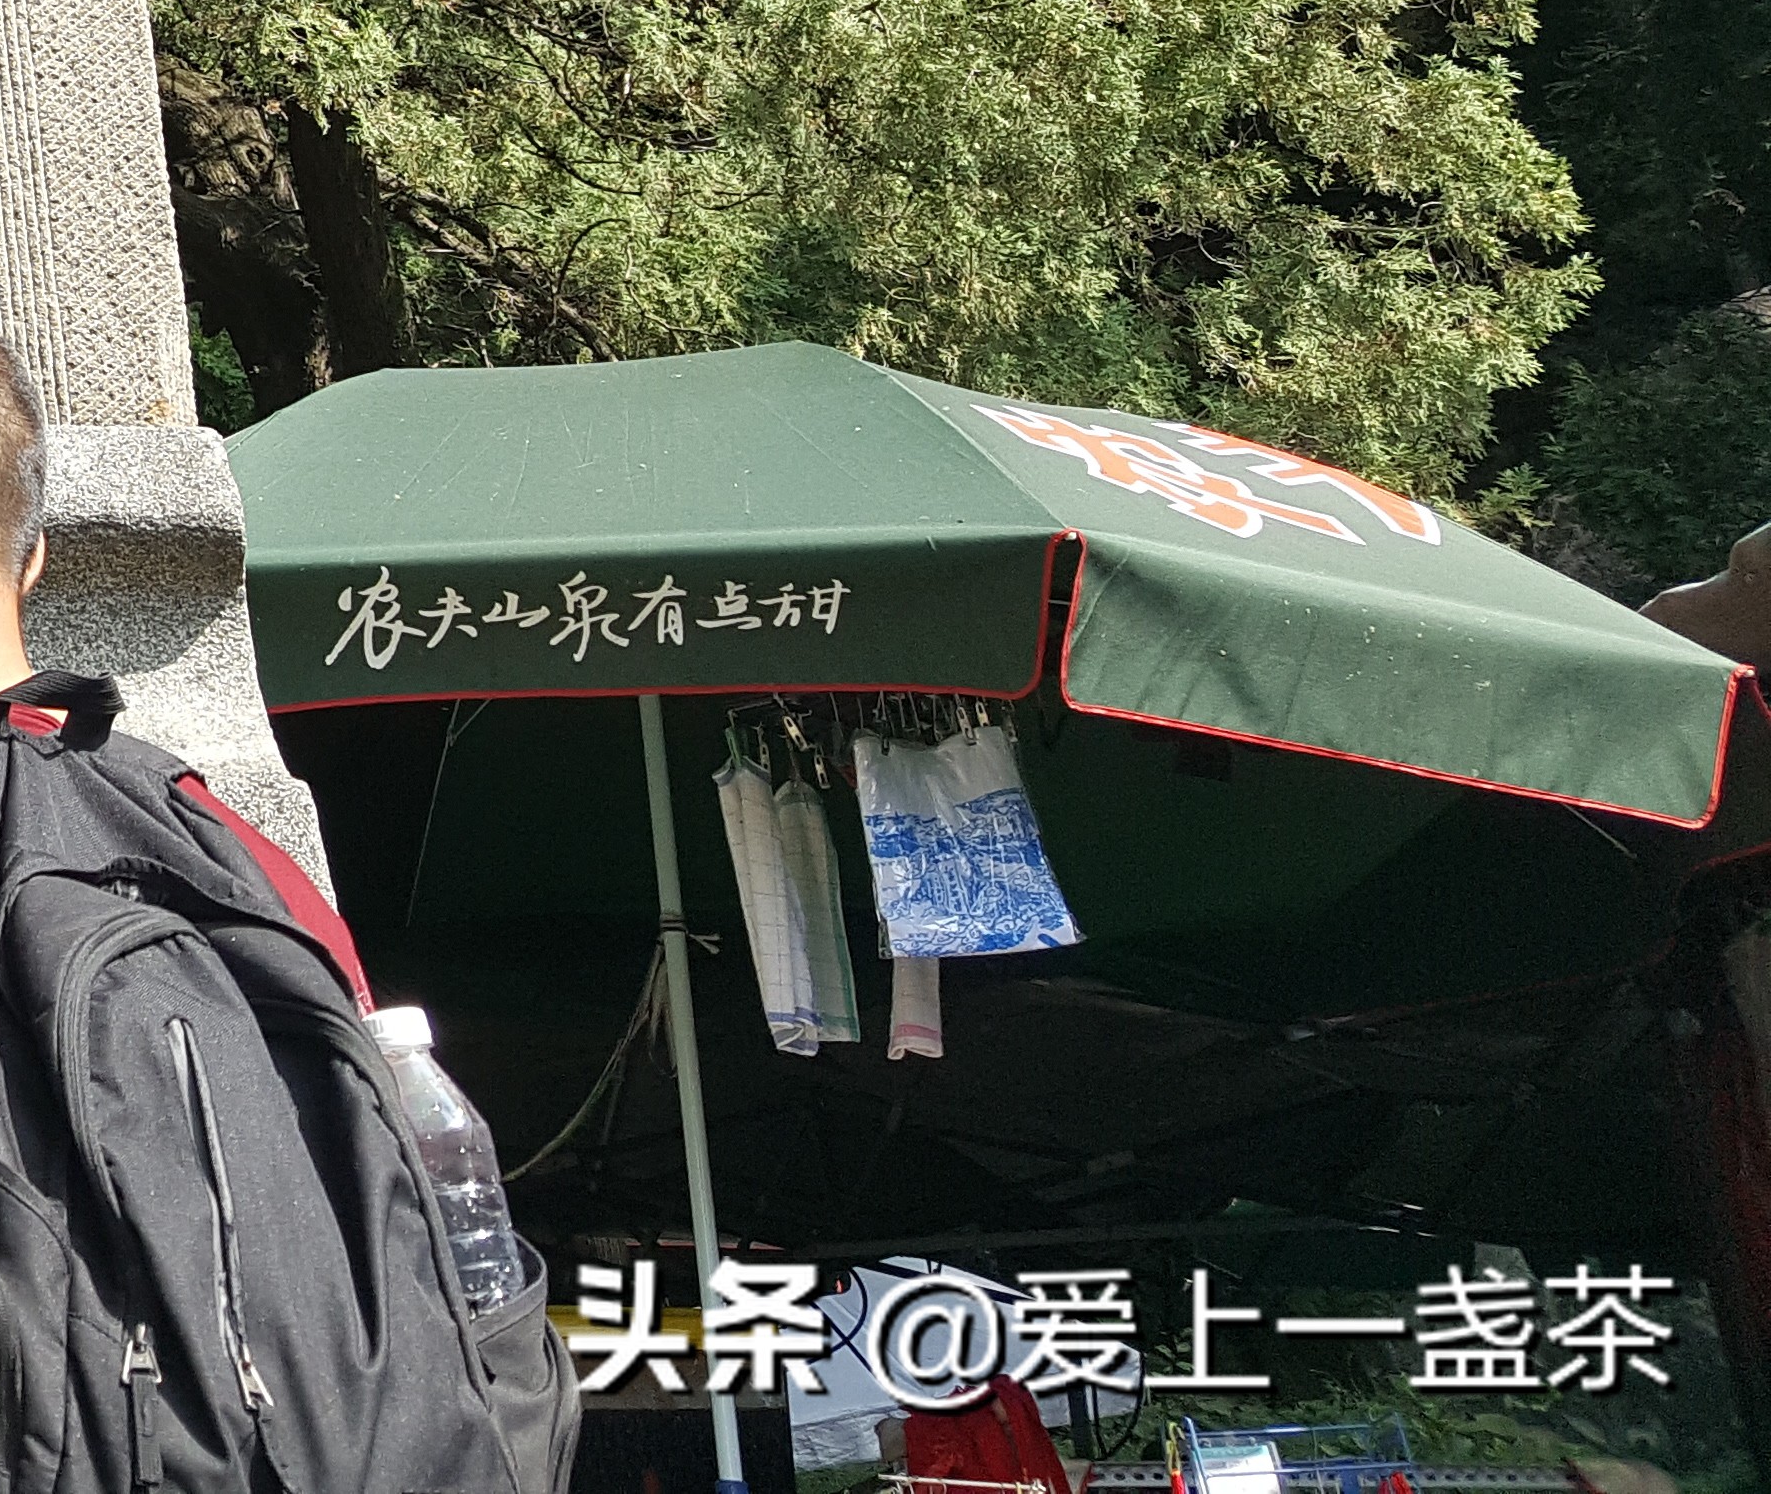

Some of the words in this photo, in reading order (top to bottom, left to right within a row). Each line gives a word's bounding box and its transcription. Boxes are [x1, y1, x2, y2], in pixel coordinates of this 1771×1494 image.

[326, 566, 851, 669] 农夫山泉有点甜
